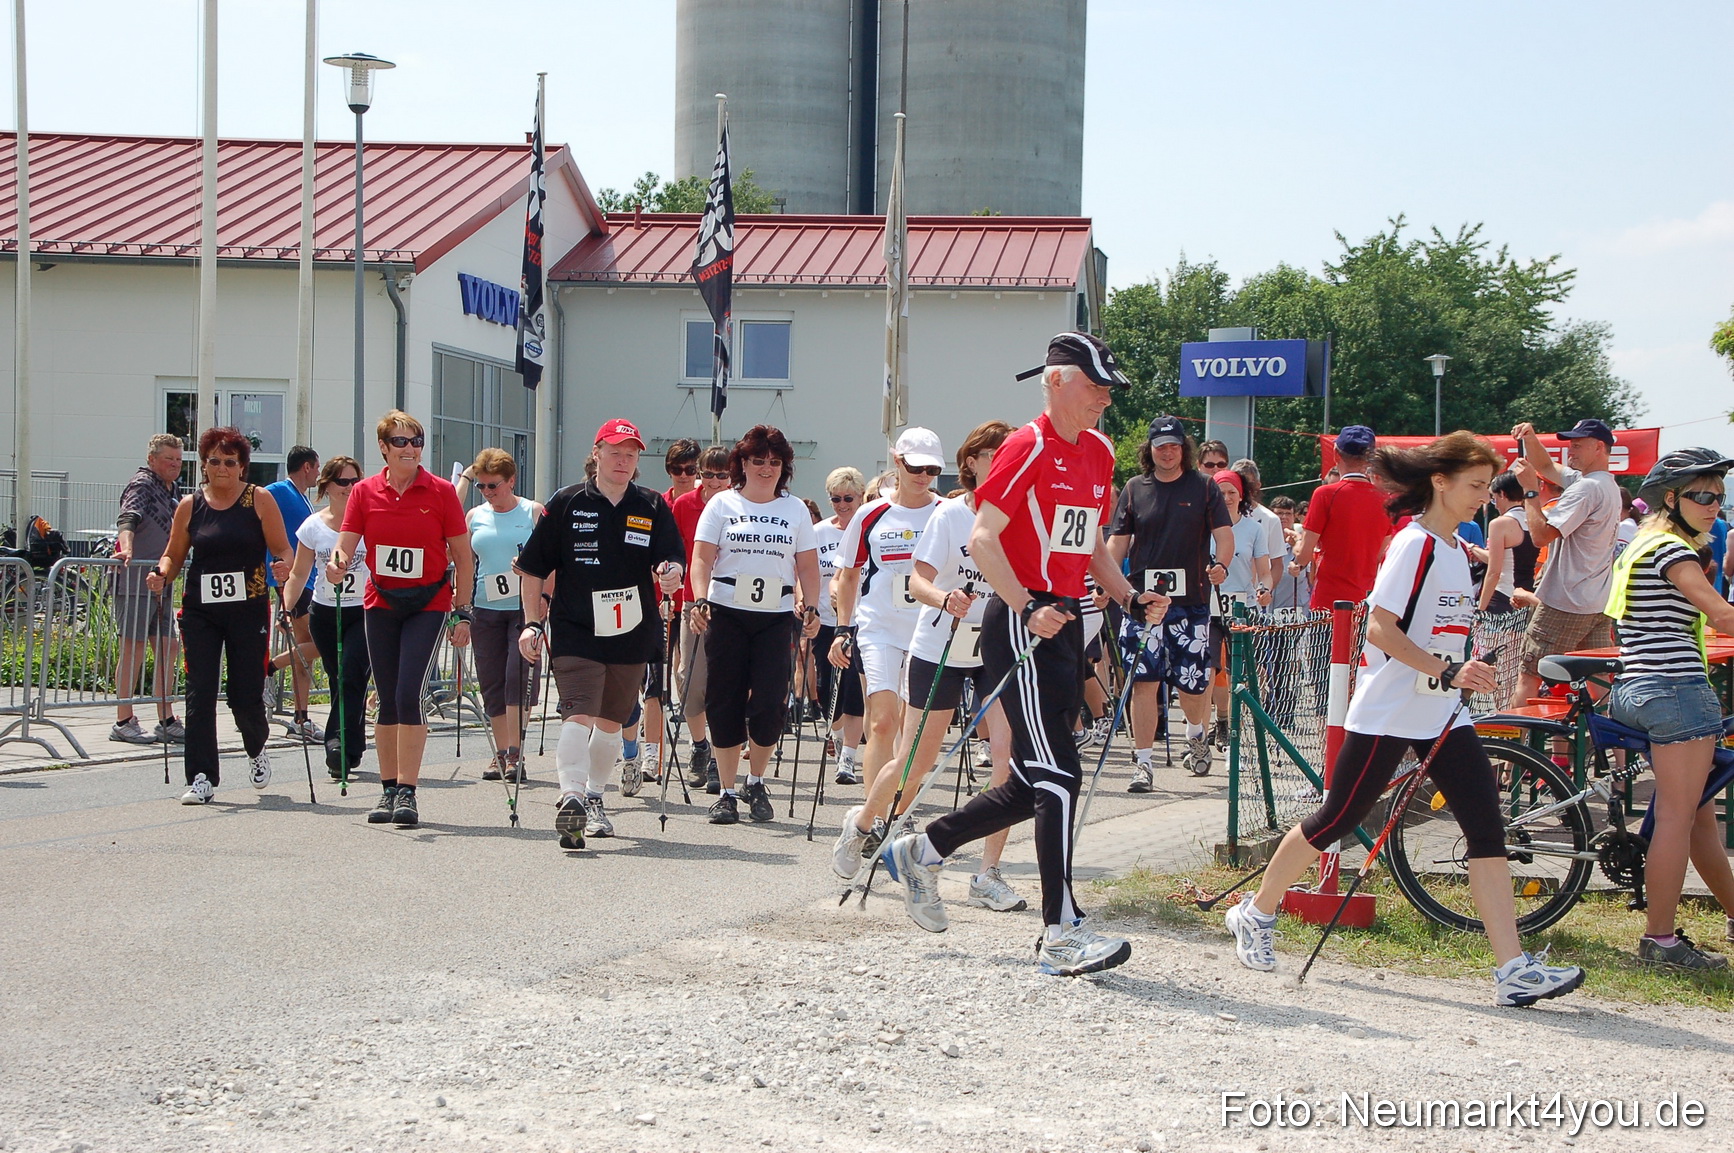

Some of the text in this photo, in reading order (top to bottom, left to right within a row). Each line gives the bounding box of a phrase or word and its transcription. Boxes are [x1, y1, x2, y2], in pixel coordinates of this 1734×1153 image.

[457, 273, 519, 331] VOLV
[1191, 356, 1287, 378] VOLVO
[729, 515, 789, 529] BERGER
[1060, 508, 1088, 548] 28
[726, 532, 793, 545] POWER GIRLS
[385, 548, 414, 574] 40
[765, 549, 785, 559] talking
[210, 574, 236, 599] 93
[496, 574, 510, 595] 8
[601, 591, 624, 599] MEYER
[750, 577, 765, 603] 3
[613, 603, 622, 629] 1
